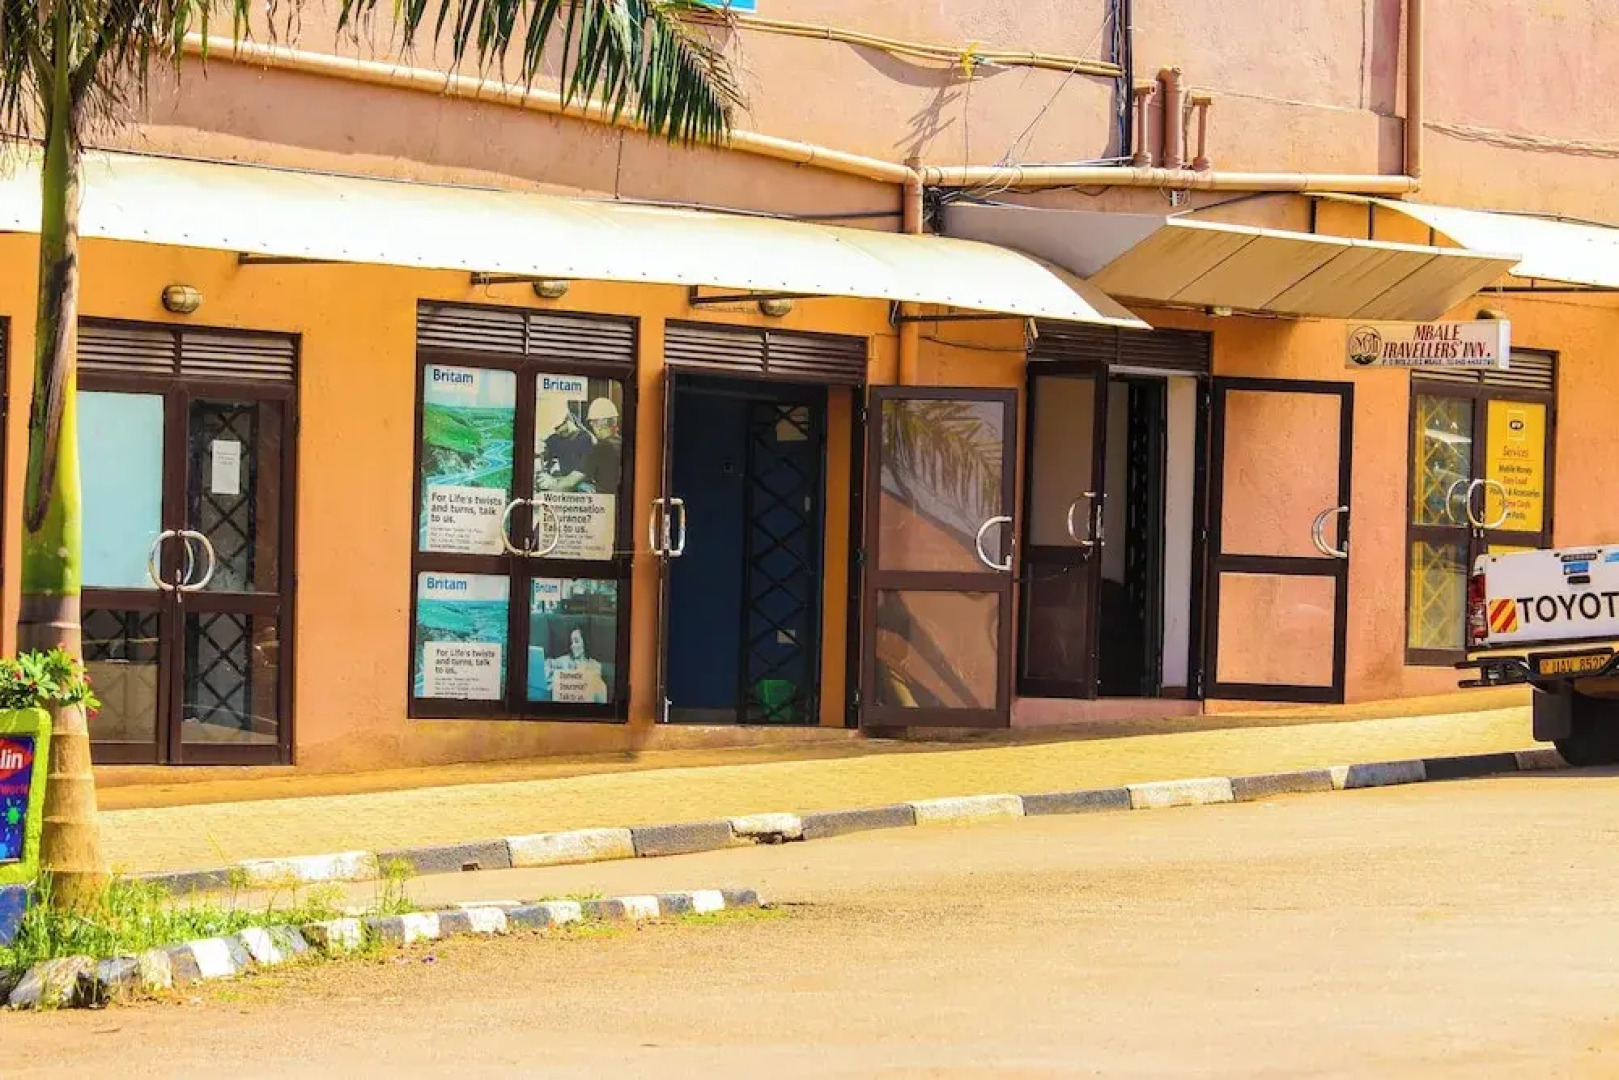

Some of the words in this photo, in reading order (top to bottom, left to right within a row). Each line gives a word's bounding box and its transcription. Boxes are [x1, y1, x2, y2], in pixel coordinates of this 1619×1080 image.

[1413, 324, 1461, 341] MBALE
[1382, 342, 1462, 359] TRAVELLERS'
[433, 369, 473, 385] Britam
[543, 378, 582, 392] Britam
[1503, 445, 1529, 458] Services
[431, 492, 447, 501] For
[450, 493, 472, 504] Life's
[475, 496, 502, 506] twists
[543, 493, 593, 504] Workmen's
[431, 504, 448, 513] and
[451, 505, 476, 515] turns,
[479, 506, 496, 516] talk
[431, 514, 441, 522] to
[443, 515, 456, 524] us.
[563, 524, 573, 533] to
[575, 525, 588, 534] us.
[426, 576, 467, 592] Britam
[1517, 591, 1619, 623] TOYOT
[436, 648, 448, 657] For
[450, 648, 470, 657] Life's
[435, 657, 450, 665] and
[476, 658, 490, 666] talk
[435, 666, 443, 674] to
